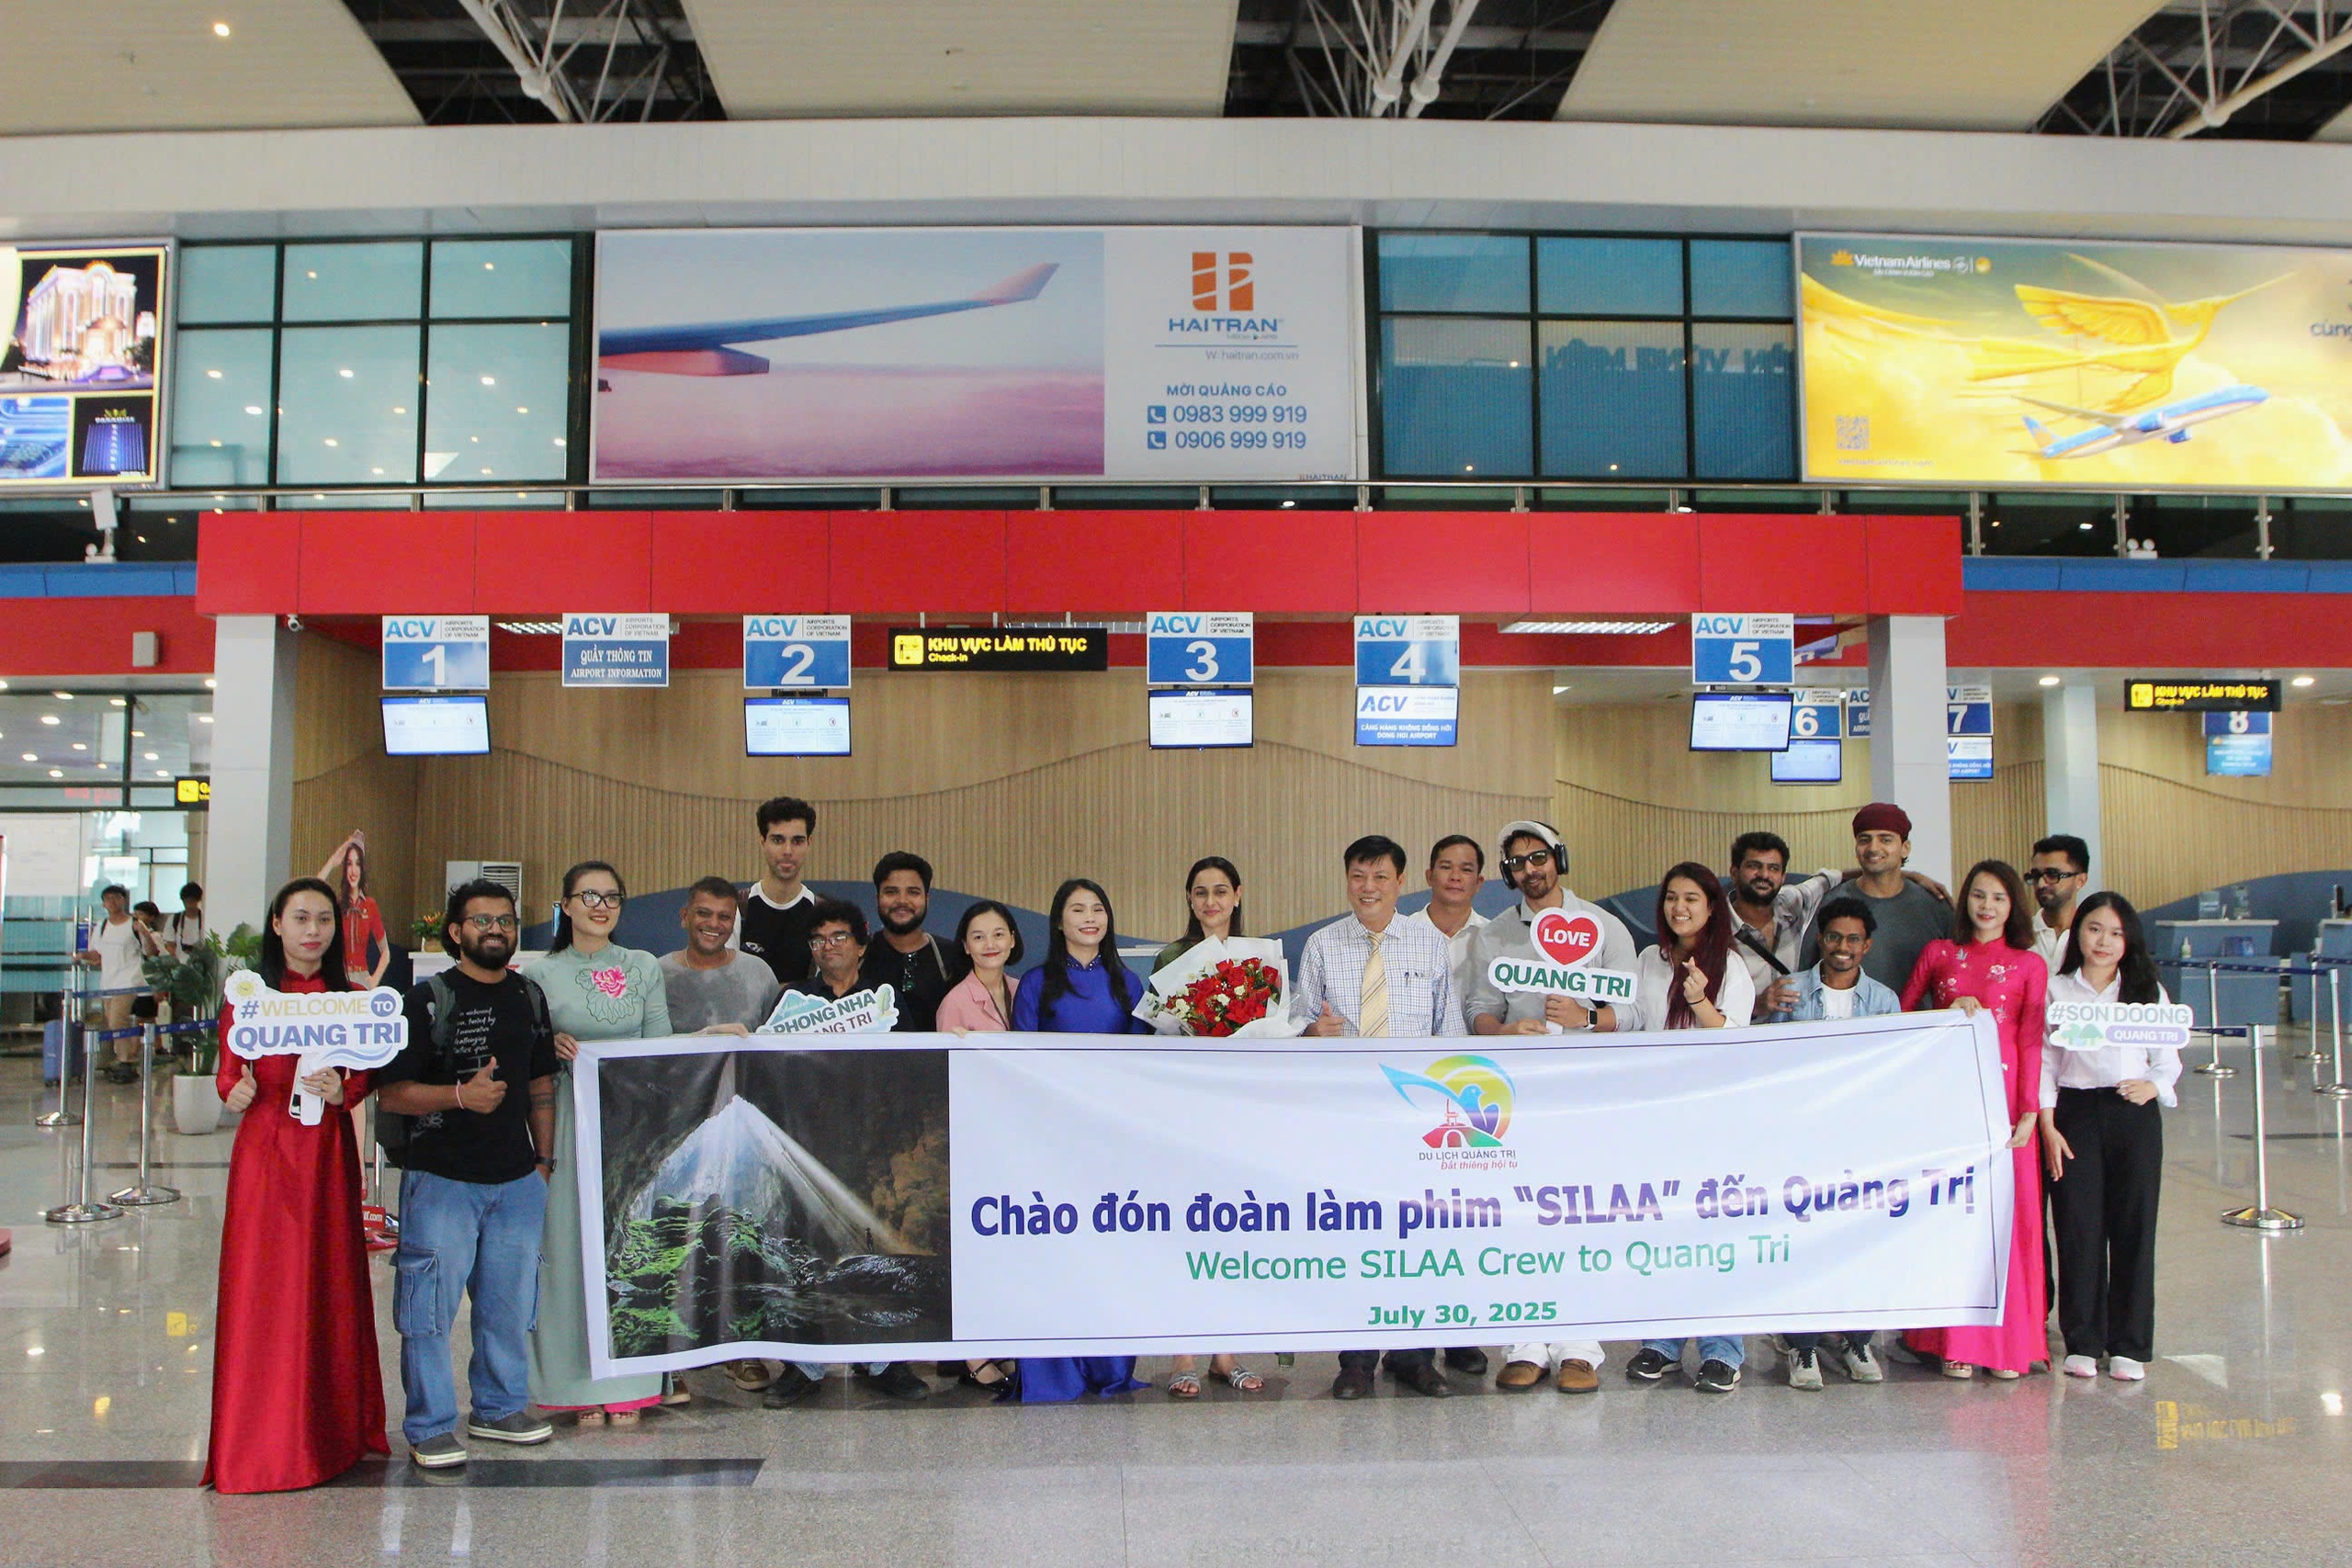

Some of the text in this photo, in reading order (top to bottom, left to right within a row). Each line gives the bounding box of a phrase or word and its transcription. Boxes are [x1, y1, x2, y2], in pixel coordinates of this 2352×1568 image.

[1854, 254, 1951, 270] Vietnam Airlines
[1166, 382, 1287, 397] MỜI QUẢNG CÁO
[1172, 405, 1307, 423] 0983 999 919
[1175, 431, 1306, 449] 0906 999 919
[386, 620, 435, 637] ACV
[567, 617, 616, 636] ACV
[747, 618, 797, 637] ACV
[1150, 616, 1201, 633] ACV
[1358, 619, 1408, 637] ACV
[1695, 616, 1743, 634] ACV
[606, 647, 635, 661] THÔNG
[638, 650, 652, 661] TIN
[928, 635, 1087, 654] KHU VỰC LÀM THỦ TỤC
[422, 645, 445, 685] 1
[781, 644, 815, 684] 2
[928, 653, 968, 662] Check-in
[1185, 640, 1219, 681] 3
[1390, 643, 1426, 683] 4
[1729, 642, 1762, 682] 5
[571, 668, 662, 678] AIRPORT INFORMATION
[1849, 690, 1870, 702] AC
[2154, 686, 2177, 697] KHU
[2178, 686, 2201, 699] VỰC
[2201, 684, 2223, 697] LÀM
[2246, 686, 2267, 699] TỤC
[1360, 696, 1408, 712] ACV
[1794, 707, 1818, 736] 6
[1949, 705, 1968, 732] 7
[2229, 711, 2249, 734] 8
[1544, 928, 1590, 947] LOVE
[1495, 964, 1632, 998] QUANG TRI
[241, 998, 393, 1019] #WELCOME TO
[774, 1007, 836, 1032] PHONG
[837, 992, 876, 1015] NHA
[2051, 1005, 2188, 1024] #SON DOONG
[488, 1016, 496, 1026] by
[847, 1011, 872, 1030] TRI
[235, 1022, 401, 1051] QUANG TRI
[2114, 1030, 2178, 1041] QUANG TRI
[1419, 1149, 1516, 1162] DU LỊCH QUẢNG TRỊ
[1441, 1160, 1518, 1171] Đất thiêng hội tụ
[971, 1190, 1078, 1235] Chào
[1091, 1190, 1170, 1234] đón
[1185, 1190, 1290, 1233] đoàn
[1307, 1190, 1383, 1231] làm
[1398, 1188, 1502, 1238] phim
[1695, 1174, 1769, 1221] đến
[1783, 1168, 1910, 1224] Quảng
[1923, 1166, 1975, 1214] Trị
[1185, 1235, 1791, 1280] Welcome SILAA Crew to Quang Tri
[1367, 1302, 1557, 1328] July 30, 2025
